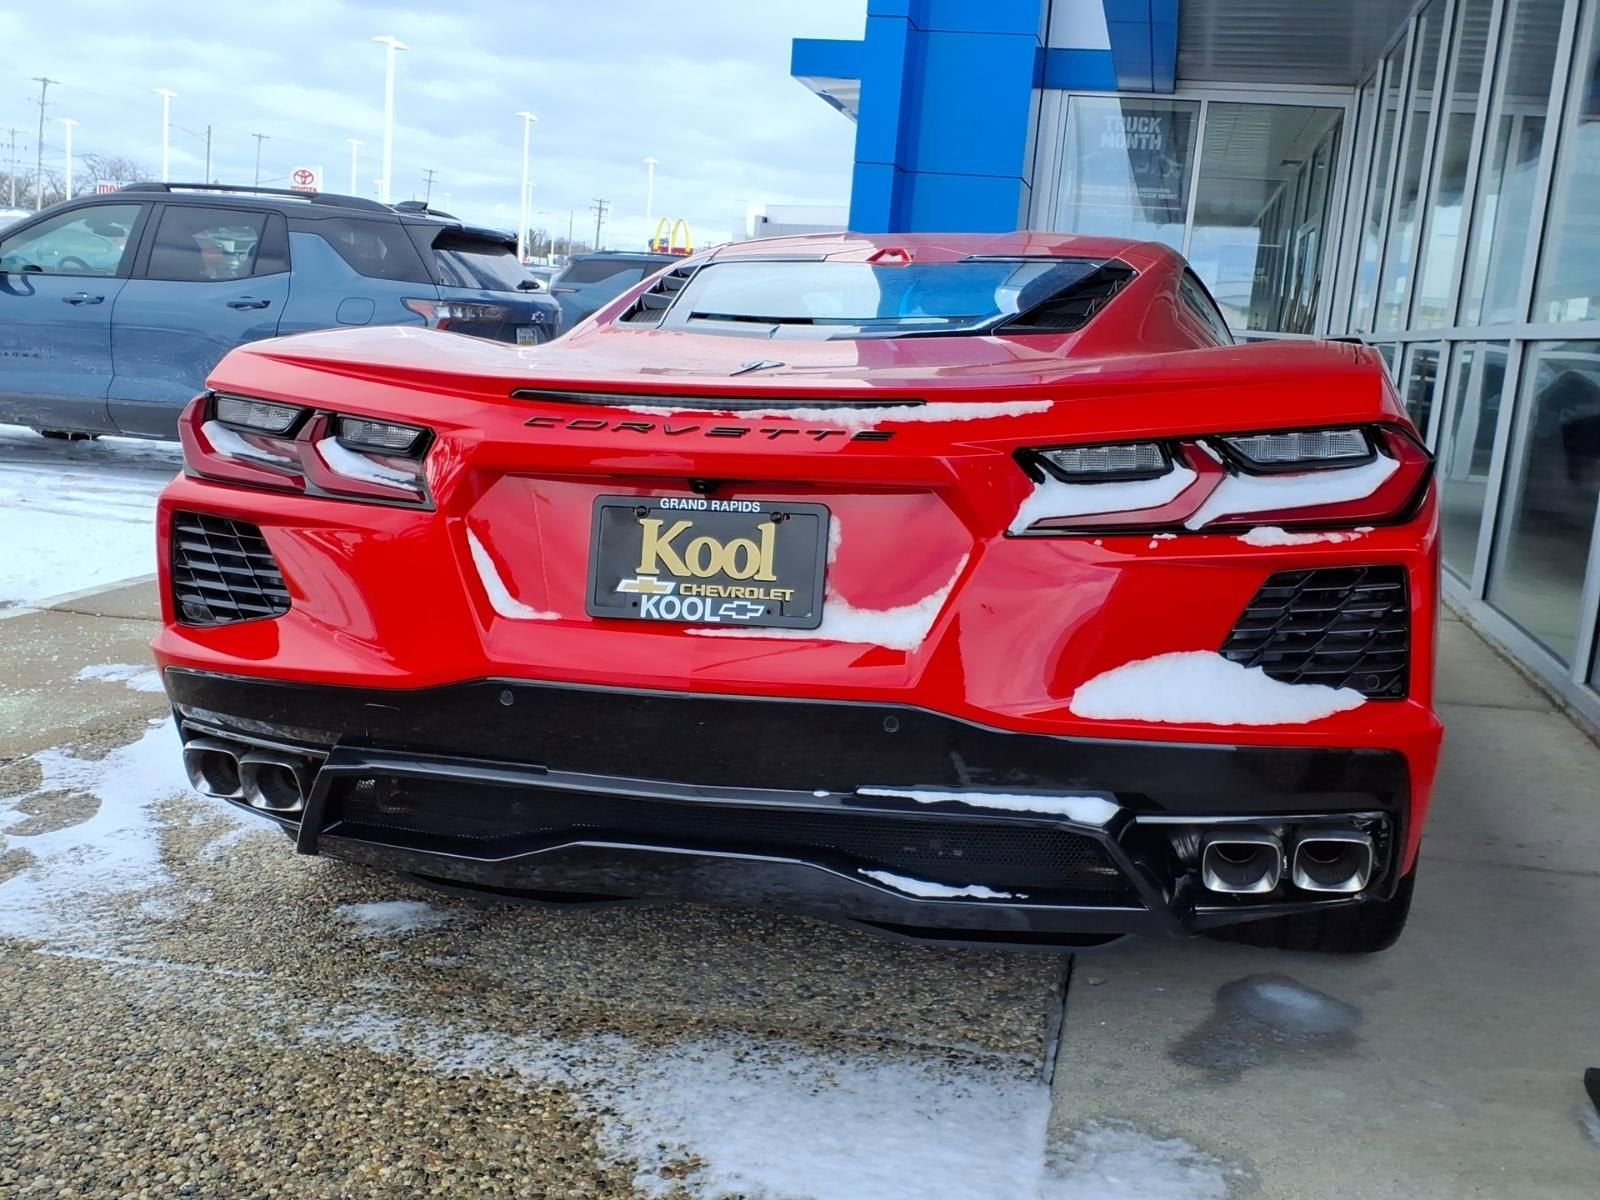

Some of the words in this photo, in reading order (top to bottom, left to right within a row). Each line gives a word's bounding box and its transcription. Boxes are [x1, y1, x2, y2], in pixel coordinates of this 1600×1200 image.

[1104, 115, 1162, 133] TRUCK
[1100, 131, 1163, 151] MONTH
[523, 415, 897, 442] CORVETTE
[660, 497, 708, 511] GRAND
[711, 499, 761, 513] RAPIDS
[635, 517, 777, 581] Kool
[679, 583, 795, 601] CHEVROLET
[640, 594, 721, 622] KOOL
